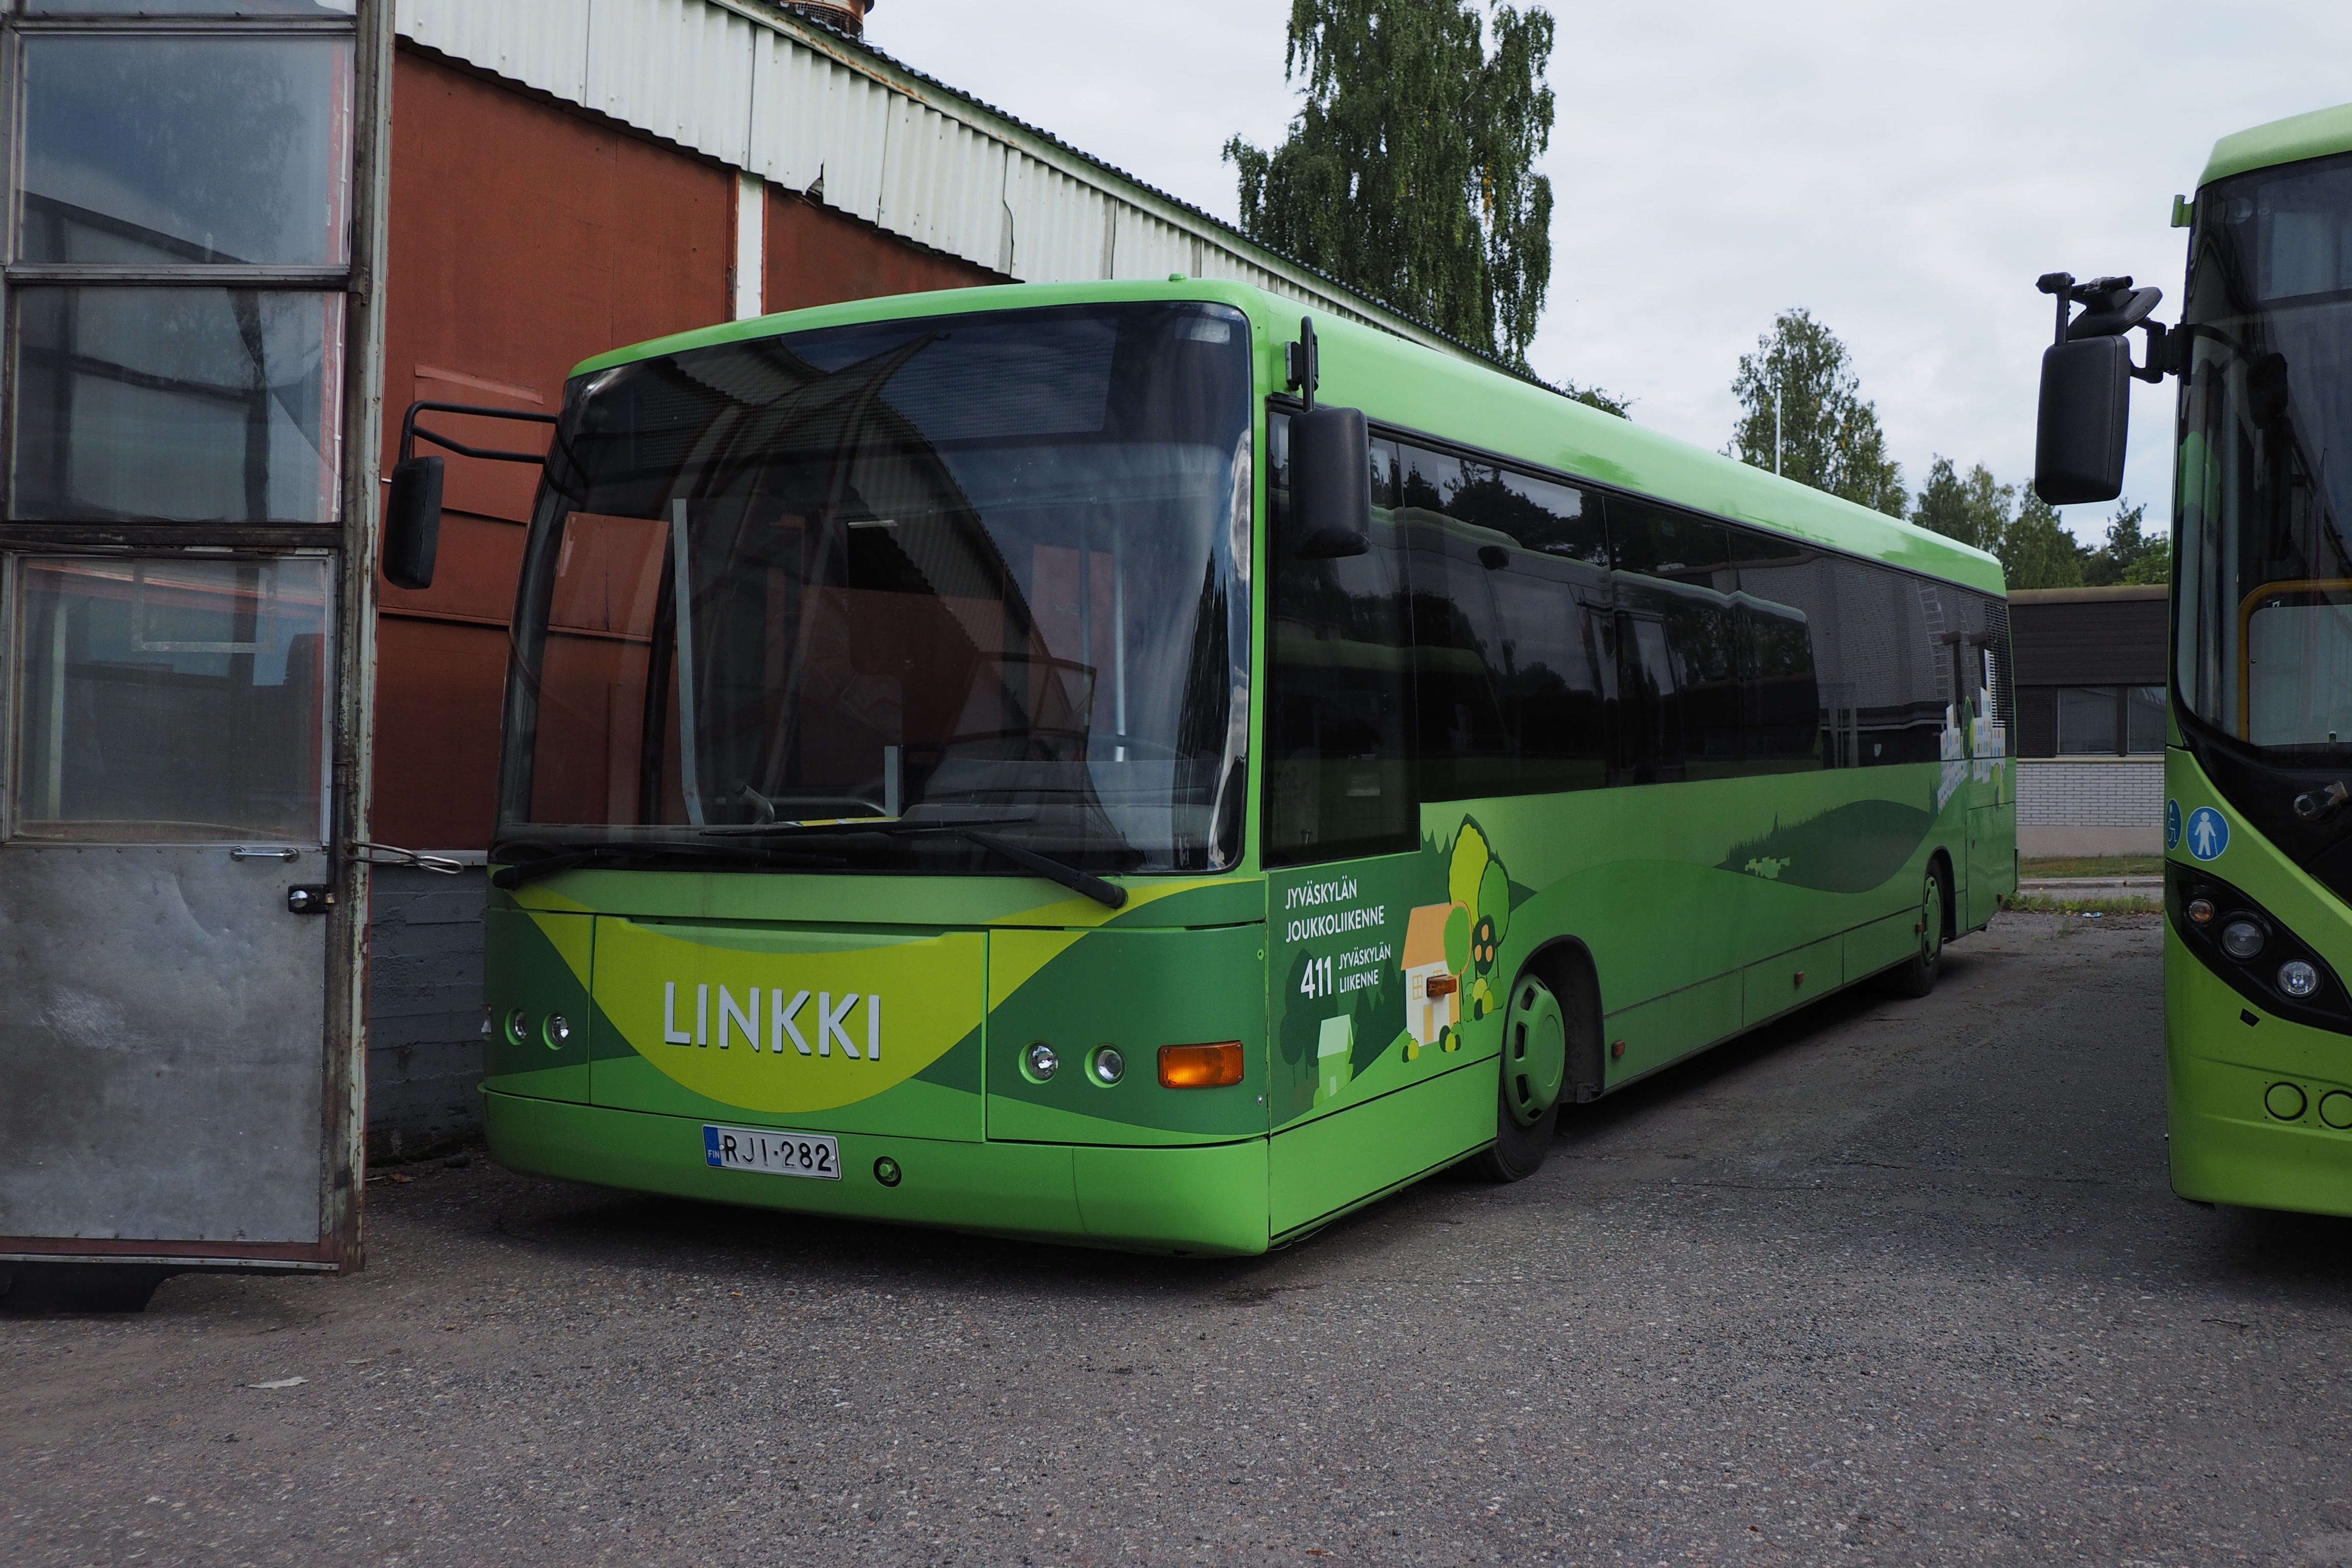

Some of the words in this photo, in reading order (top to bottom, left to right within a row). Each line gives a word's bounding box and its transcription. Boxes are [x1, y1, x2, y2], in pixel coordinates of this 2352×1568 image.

[1285, 875, 1357, 910] JYVÄSKYLÄN
[1286, 905, 1385, 943] JOUKKOLIIKENNE
[1338, 941, 1391, 970] JYVÄSKYLÄN
[1301, 955, 1332, 999] 411
[1339, 969, 1379, 993] LIIKENNE
[665, 982, 880, 1061] LINKKI
[708, 1149, 720, 1159] FIN
[723, 1135, 832, 1172] RJI-282
